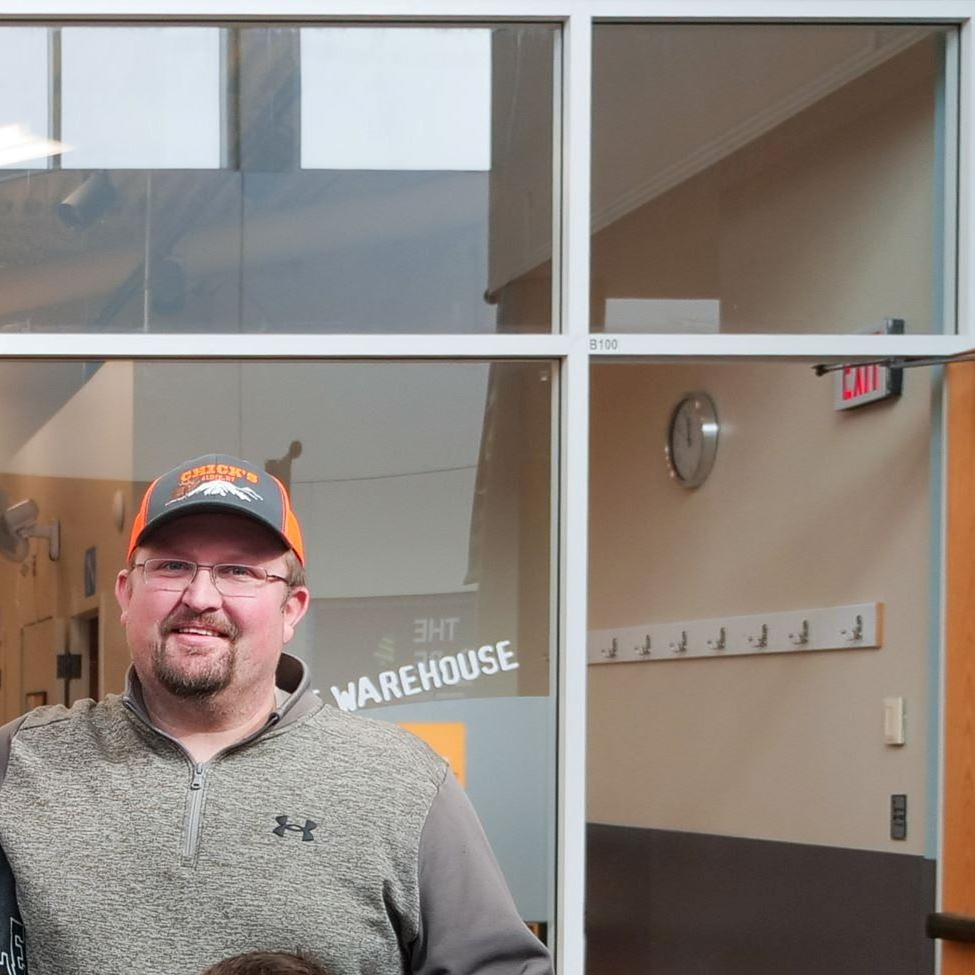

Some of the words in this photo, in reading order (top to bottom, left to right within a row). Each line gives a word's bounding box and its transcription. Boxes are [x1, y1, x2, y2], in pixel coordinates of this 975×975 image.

[589, 339, 618, 351] B100
[180, 463, 259, 485] CHICK'S
[330, 639, 520, 712] WAREHOUSE
